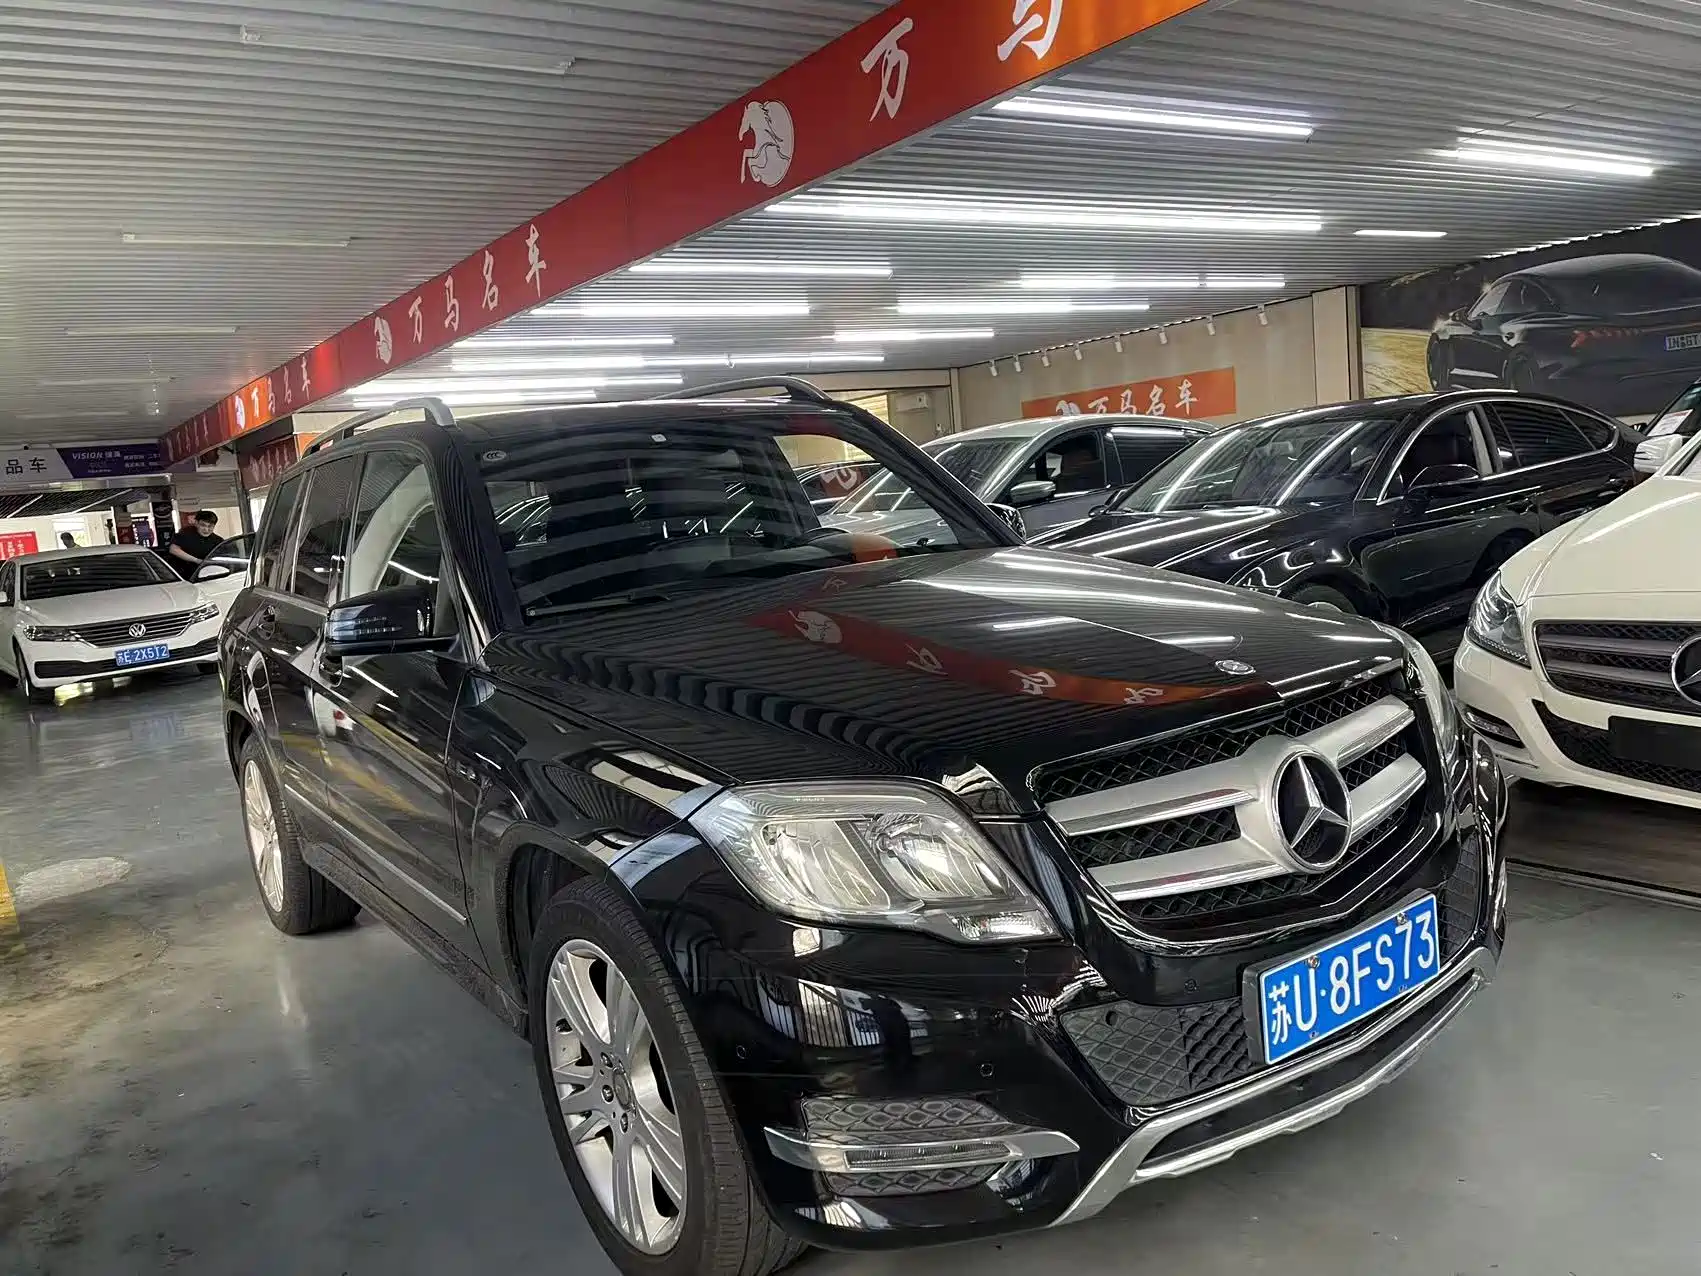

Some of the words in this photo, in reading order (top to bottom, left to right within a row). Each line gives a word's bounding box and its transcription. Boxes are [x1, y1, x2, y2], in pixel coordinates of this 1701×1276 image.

[408, 223, 547, 344] 万马名车
[5, 456, 48, 475] 品车
